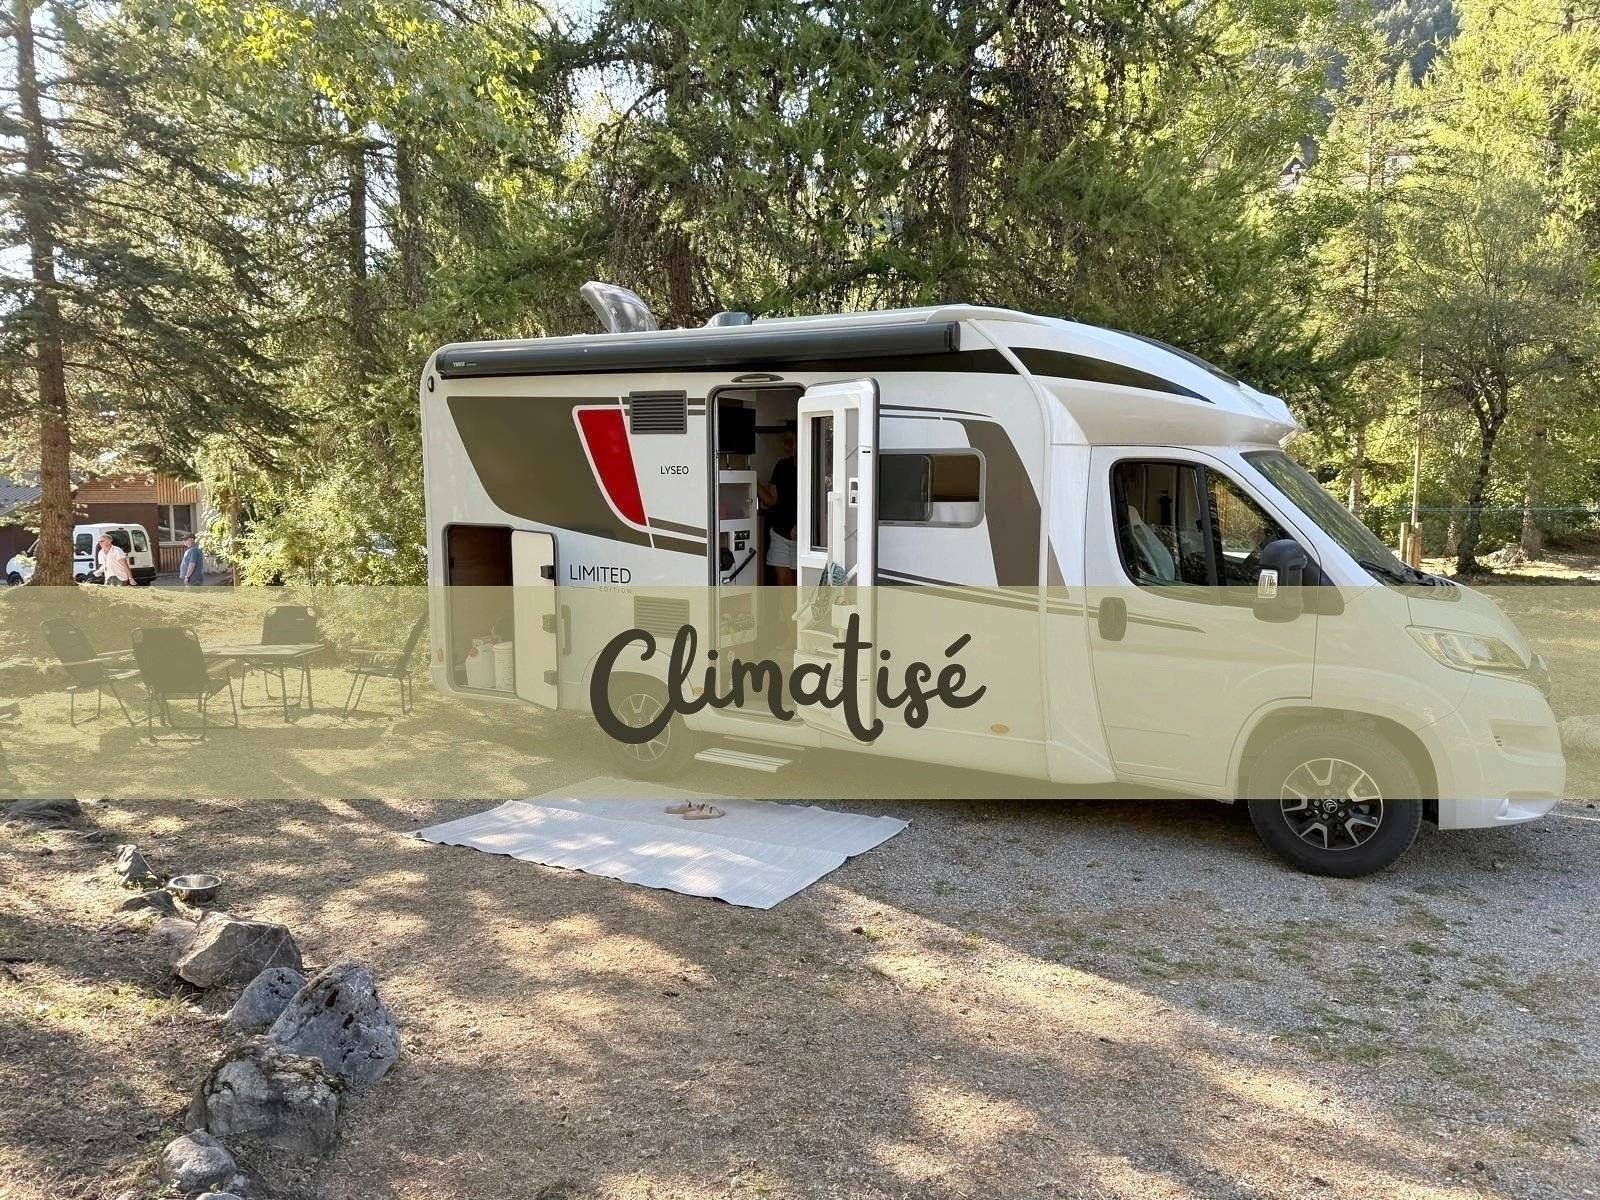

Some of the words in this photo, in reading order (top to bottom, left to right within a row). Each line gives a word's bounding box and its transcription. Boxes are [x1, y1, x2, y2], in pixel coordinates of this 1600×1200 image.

[660, 465, 690, 475] LYSEO
[569, 564, 632, 584] LIMITED
[599, 586, 632, 595] EDITION
